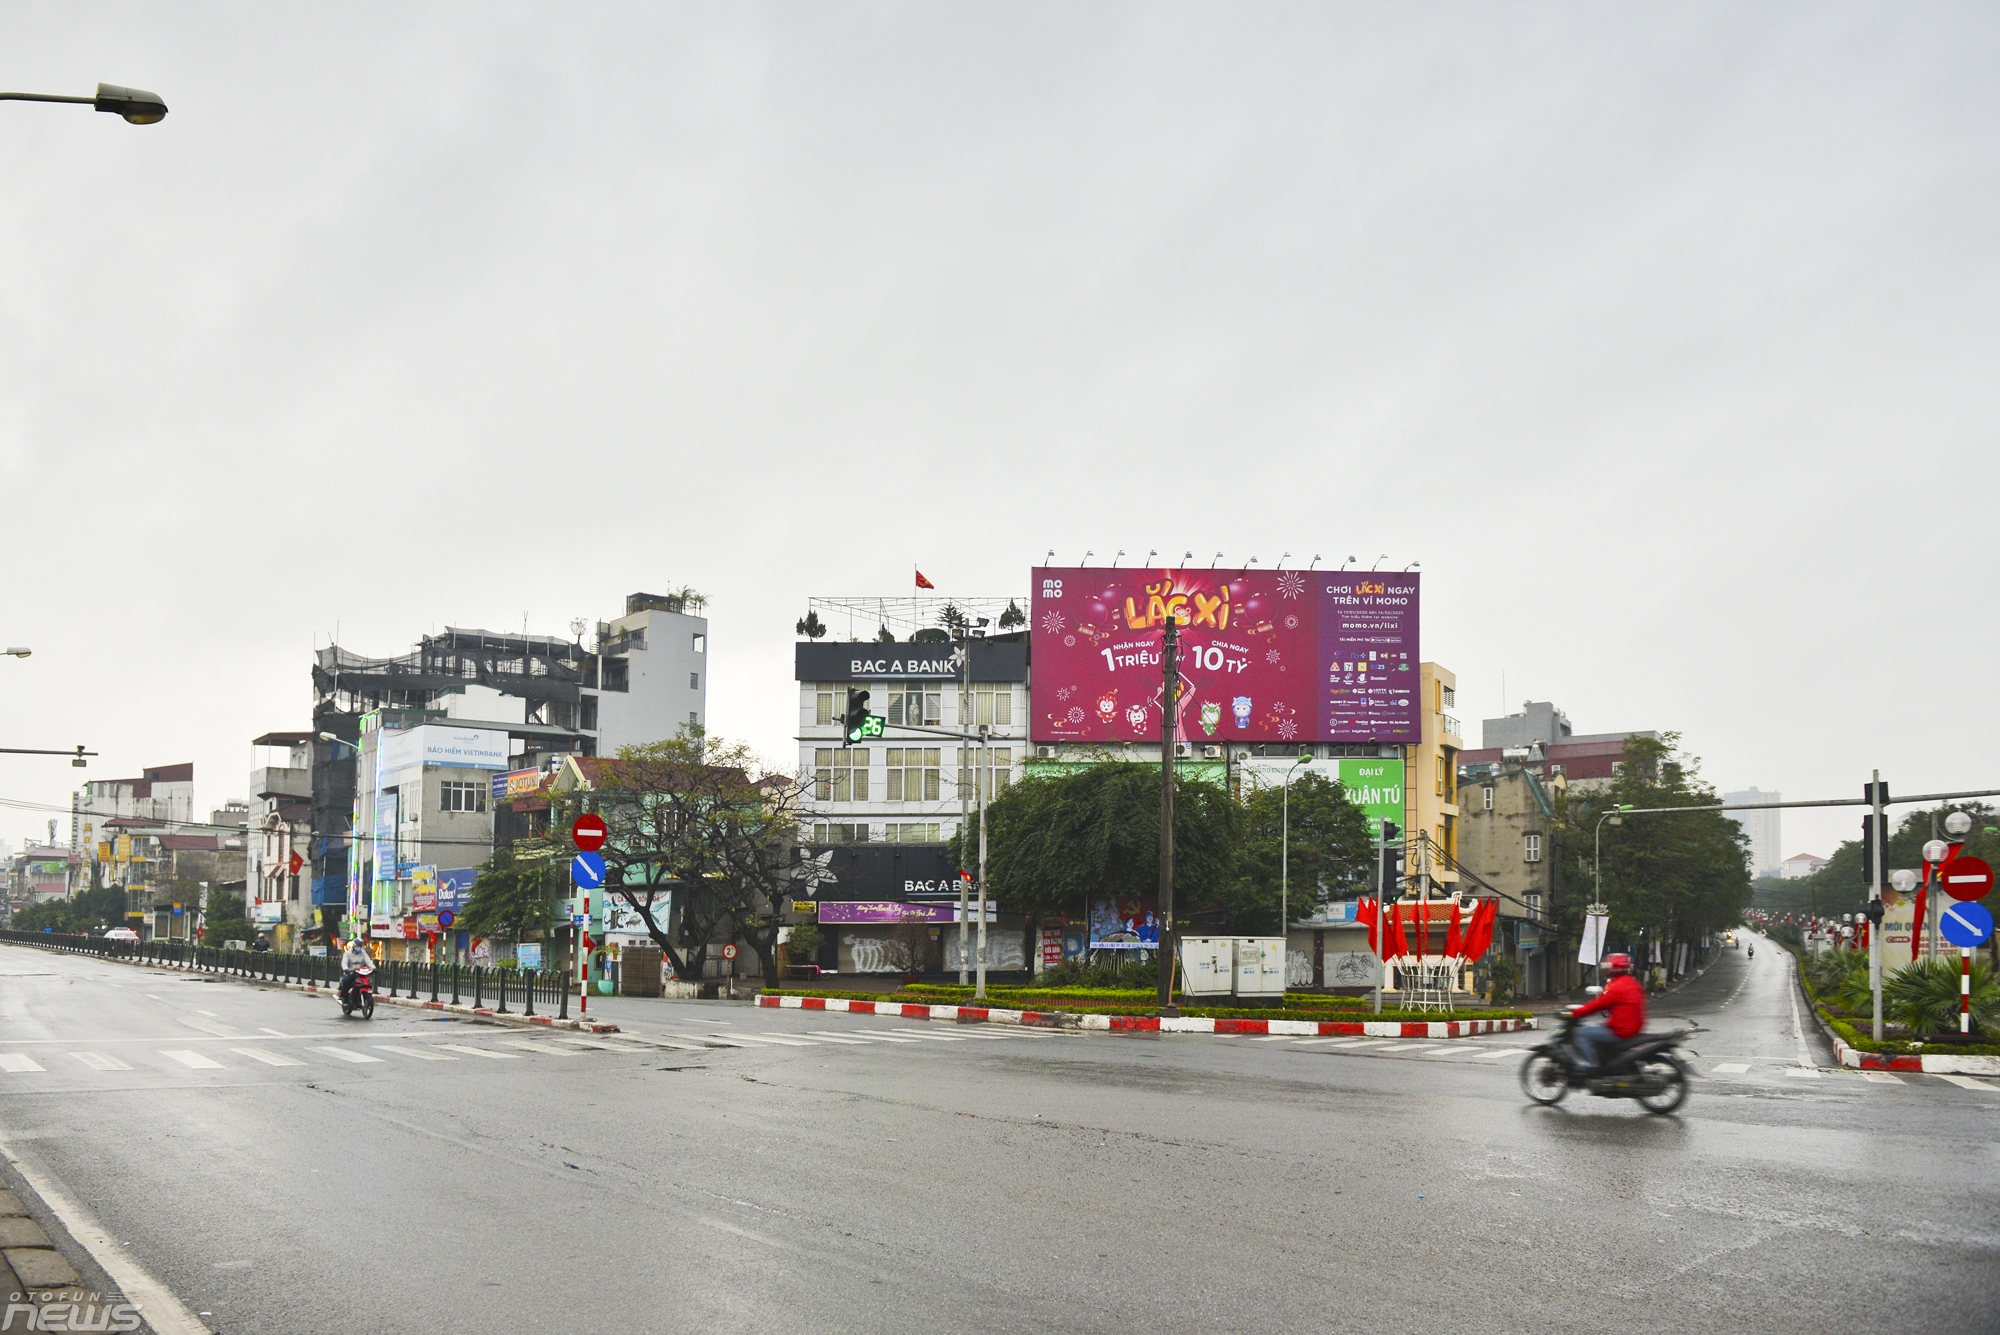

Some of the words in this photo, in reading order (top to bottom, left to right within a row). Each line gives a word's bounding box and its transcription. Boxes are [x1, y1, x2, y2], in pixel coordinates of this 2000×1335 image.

[1326, 585, 1352, 594] CHƠI
[1333, 595, 1360, 604] TRÊN
[1362, 596, 1372, 604] VÍ
[1114, 642, 1133, 650] NHẬN
[1212, 640, 1229, 649] CHIA
[1230, 644, 1249, 654] NGAY
[1115, 650, 1160, 668] TRIỆU
[1192, 646, 1224, 670] 10
[851, 660, 886, 673] BAC
[891, 660, 903, 673] A
[907, 660, 955, 673] BANK
[864, 716, 881, 735] 26
[428, 746, 443, 754] BẢO
[445, 746, 461, 754] HIỂM
[1359, 768, 1373, 777] ĐẠI
[1375, 767, 1384, 775] LÝ
[516, 776, 536, 790] JOTUN
[1344, 786, 1380, 804] XUÂN
[1383, 784, 1400, 804] TÚ
[905, 880, 935, 892] BAC
[938, 880, 949, 891] A
[439, 888, 454, 900] Dulux
